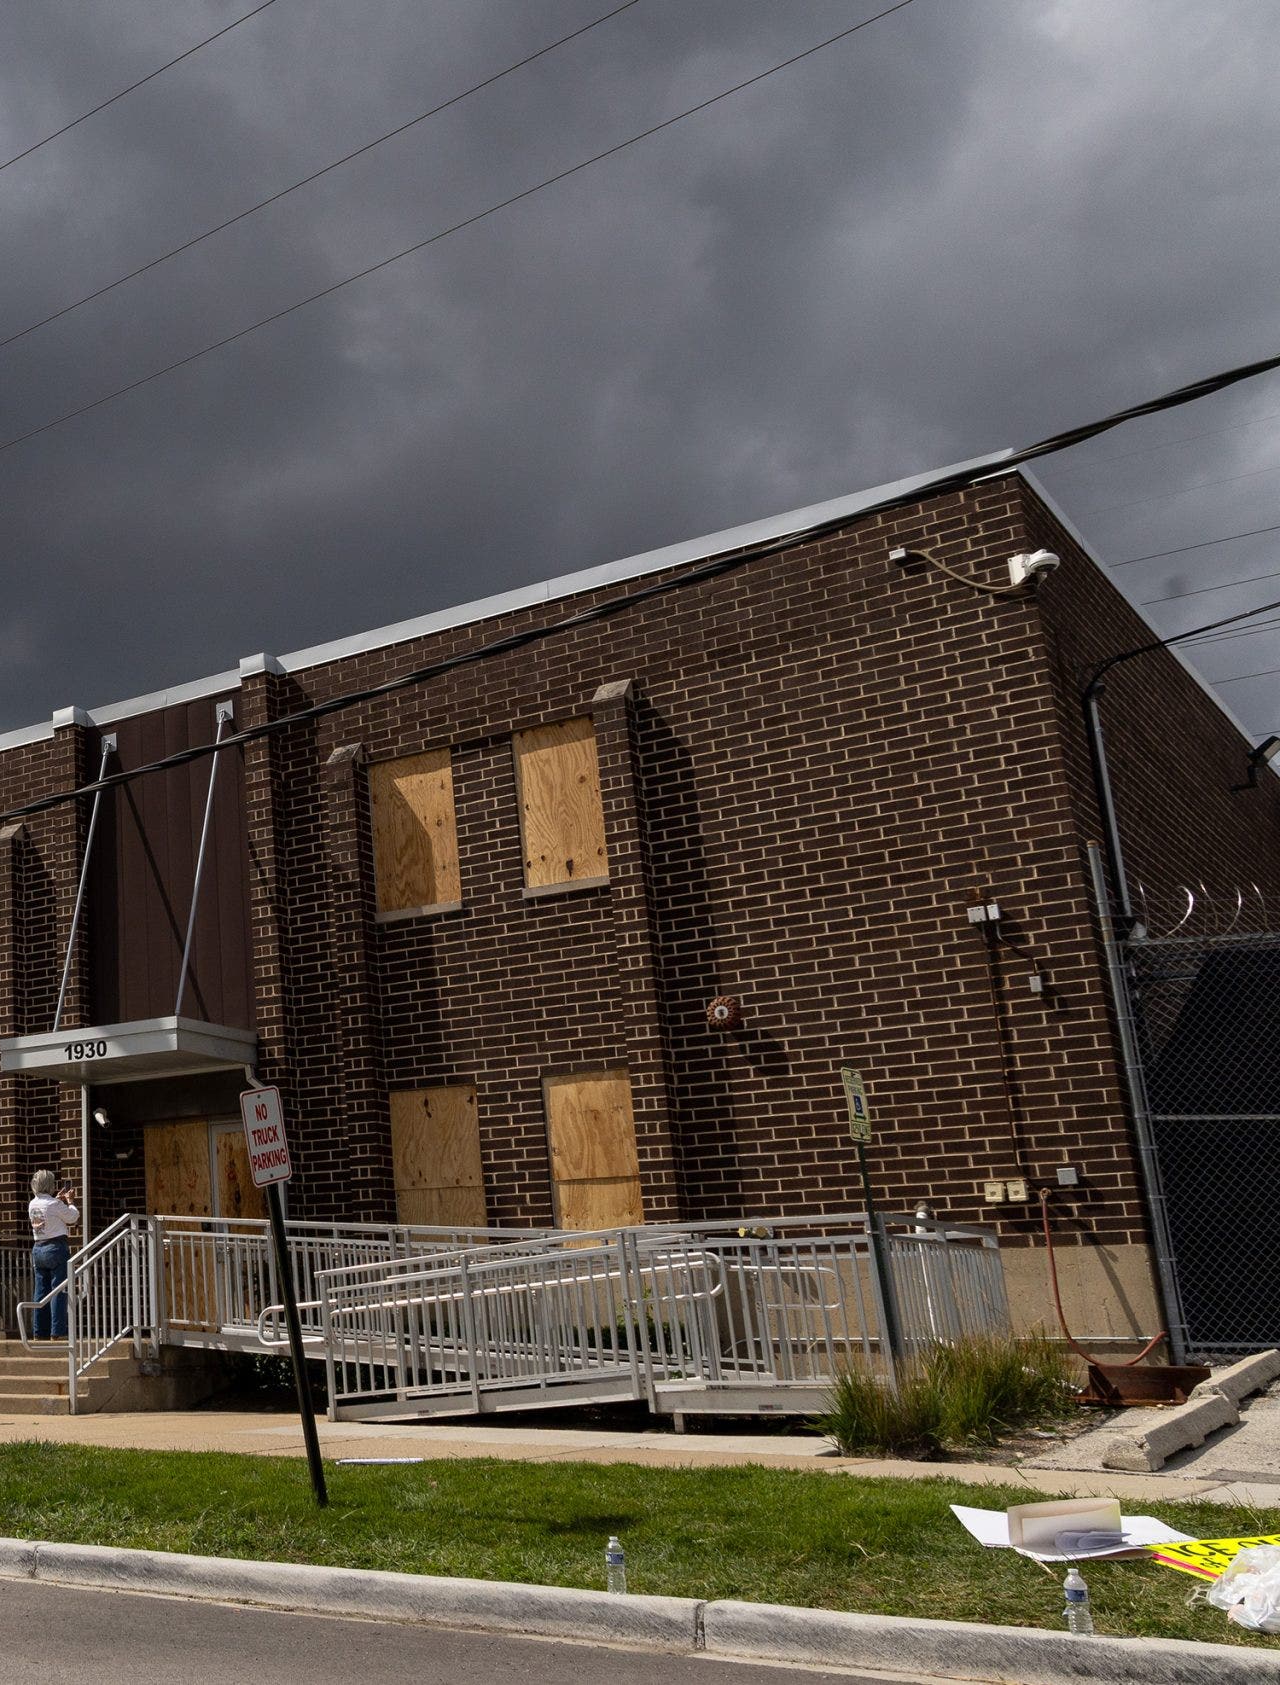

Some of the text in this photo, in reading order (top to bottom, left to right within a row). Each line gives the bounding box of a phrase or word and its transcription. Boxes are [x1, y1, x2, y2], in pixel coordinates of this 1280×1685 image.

[65, 1041, 107, 1060] 1930
[255, 1103, 268, 1121] NO
[252, 1125, 279, 1147] TRUCK
[252, 1148, 287, 1171] PARKING
[1163, 1542, 1238, 1557] ICE
